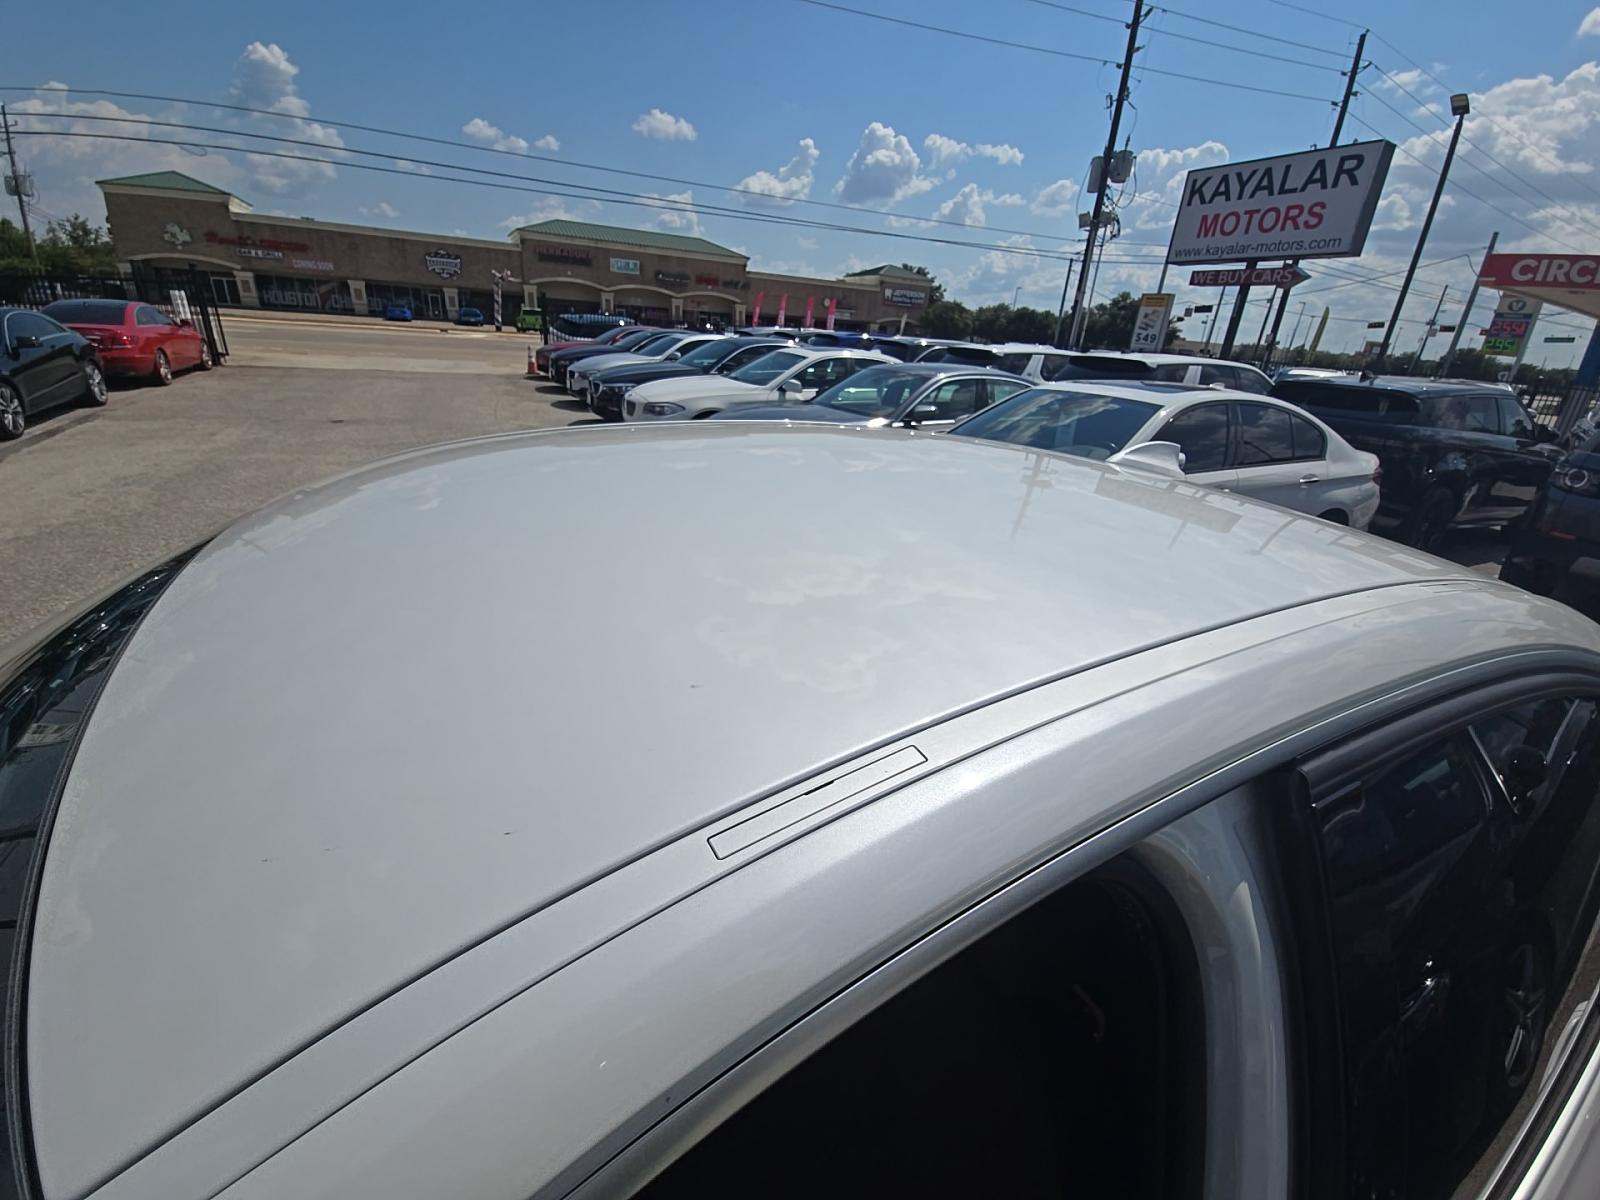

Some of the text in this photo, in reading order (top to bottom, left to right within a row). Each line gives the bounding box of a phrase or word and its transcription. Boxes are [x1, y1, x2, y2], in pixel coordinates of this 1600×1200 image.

[1187, 153, 1365, 207] KAYALAR
[1196, 201, 1327, 239] MOTORS
[1173, 237, 1343, 258] www.kayalar-motors.com
[1193, 268, 1293, 284] WE BUY CARS
[263, 289, 320, 309] HOUSTON
